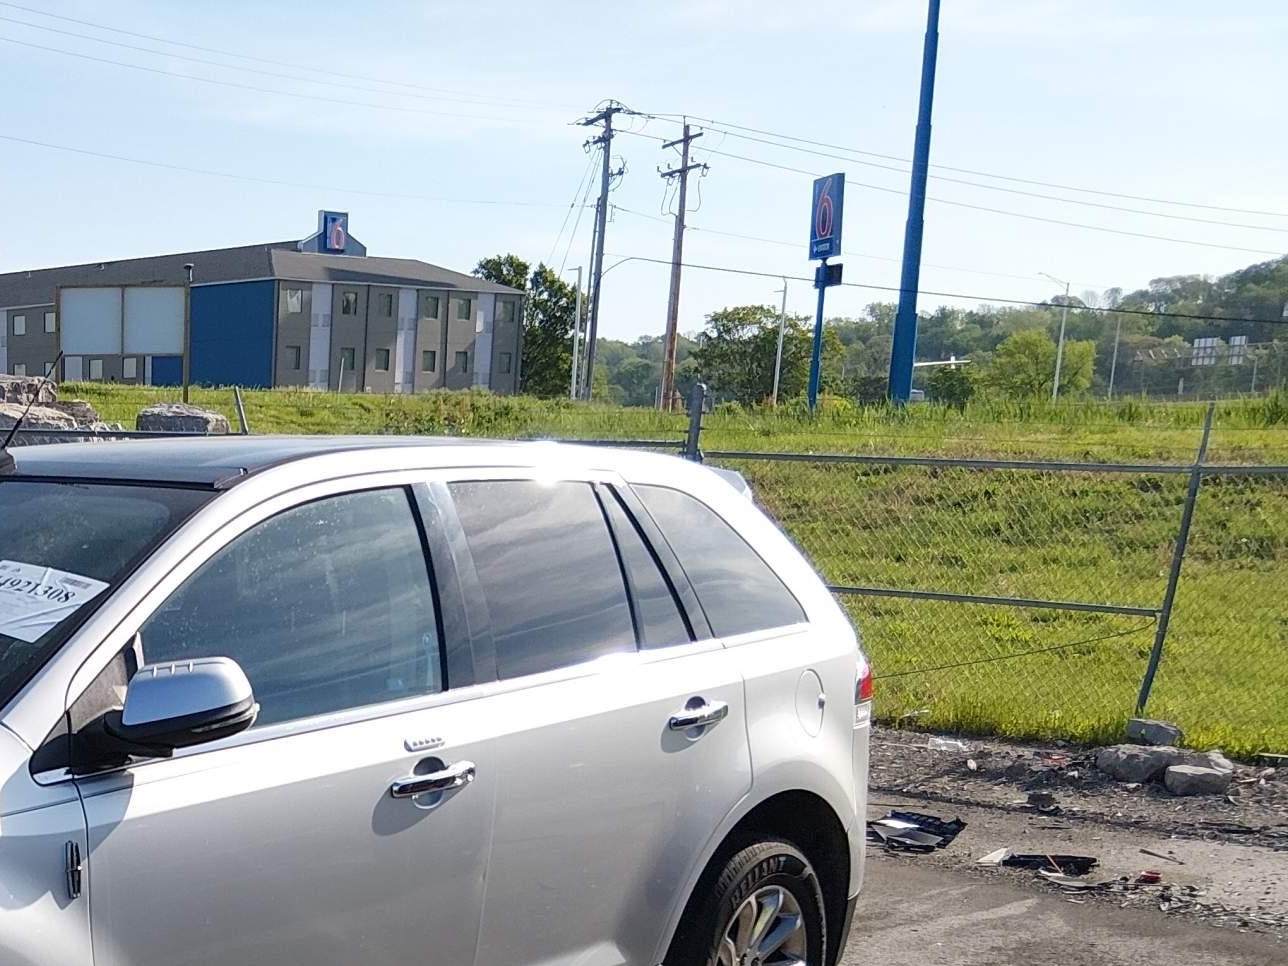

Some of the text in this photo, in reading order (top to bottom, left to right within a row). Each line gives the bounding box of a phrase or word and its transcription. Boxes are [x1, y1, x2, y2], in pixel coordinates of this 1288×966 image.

[331, 218, 345, 250] 6
[816, 178, 833, 241] 6
[731, 856, 787, 911] RELIANT
